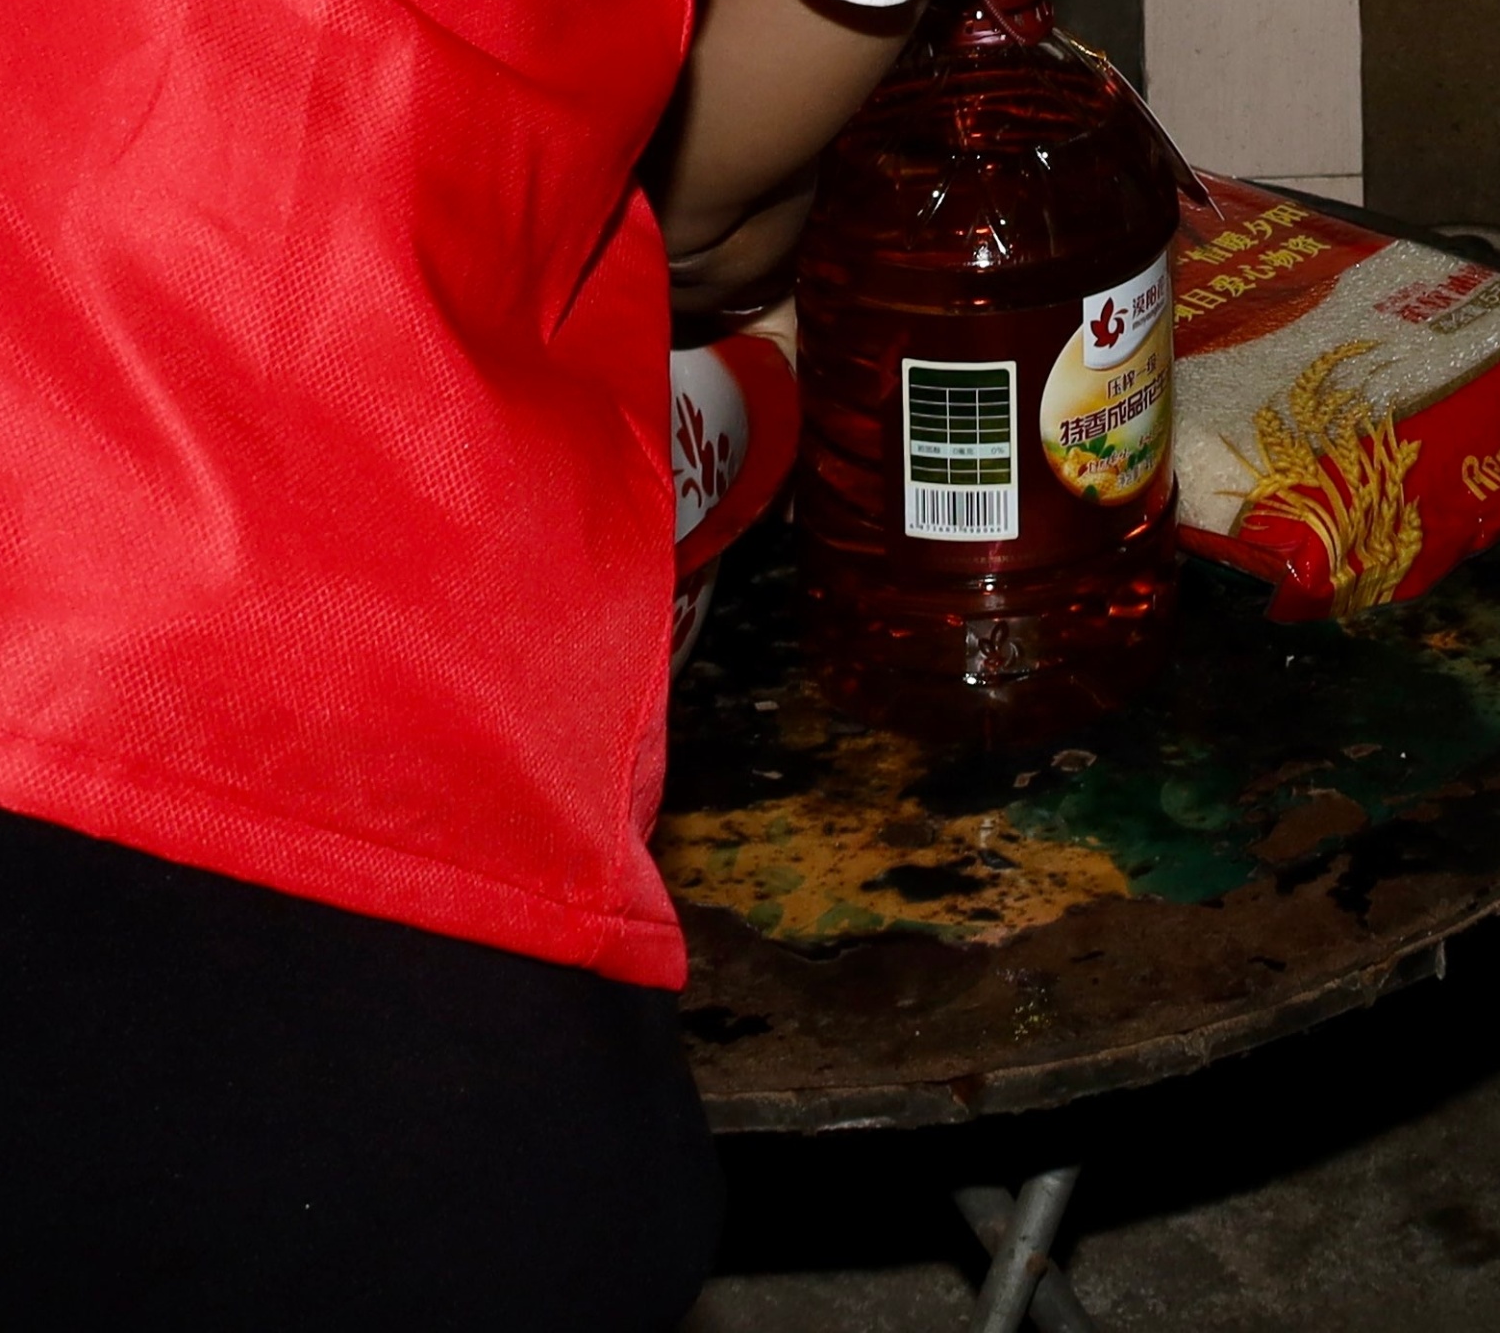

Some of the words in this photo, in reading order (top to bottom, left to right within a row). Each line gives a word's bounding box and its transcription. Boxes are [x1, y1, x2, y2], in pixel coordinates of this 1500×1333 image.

[1059, 369, 1170, 447] 特香成品花生
